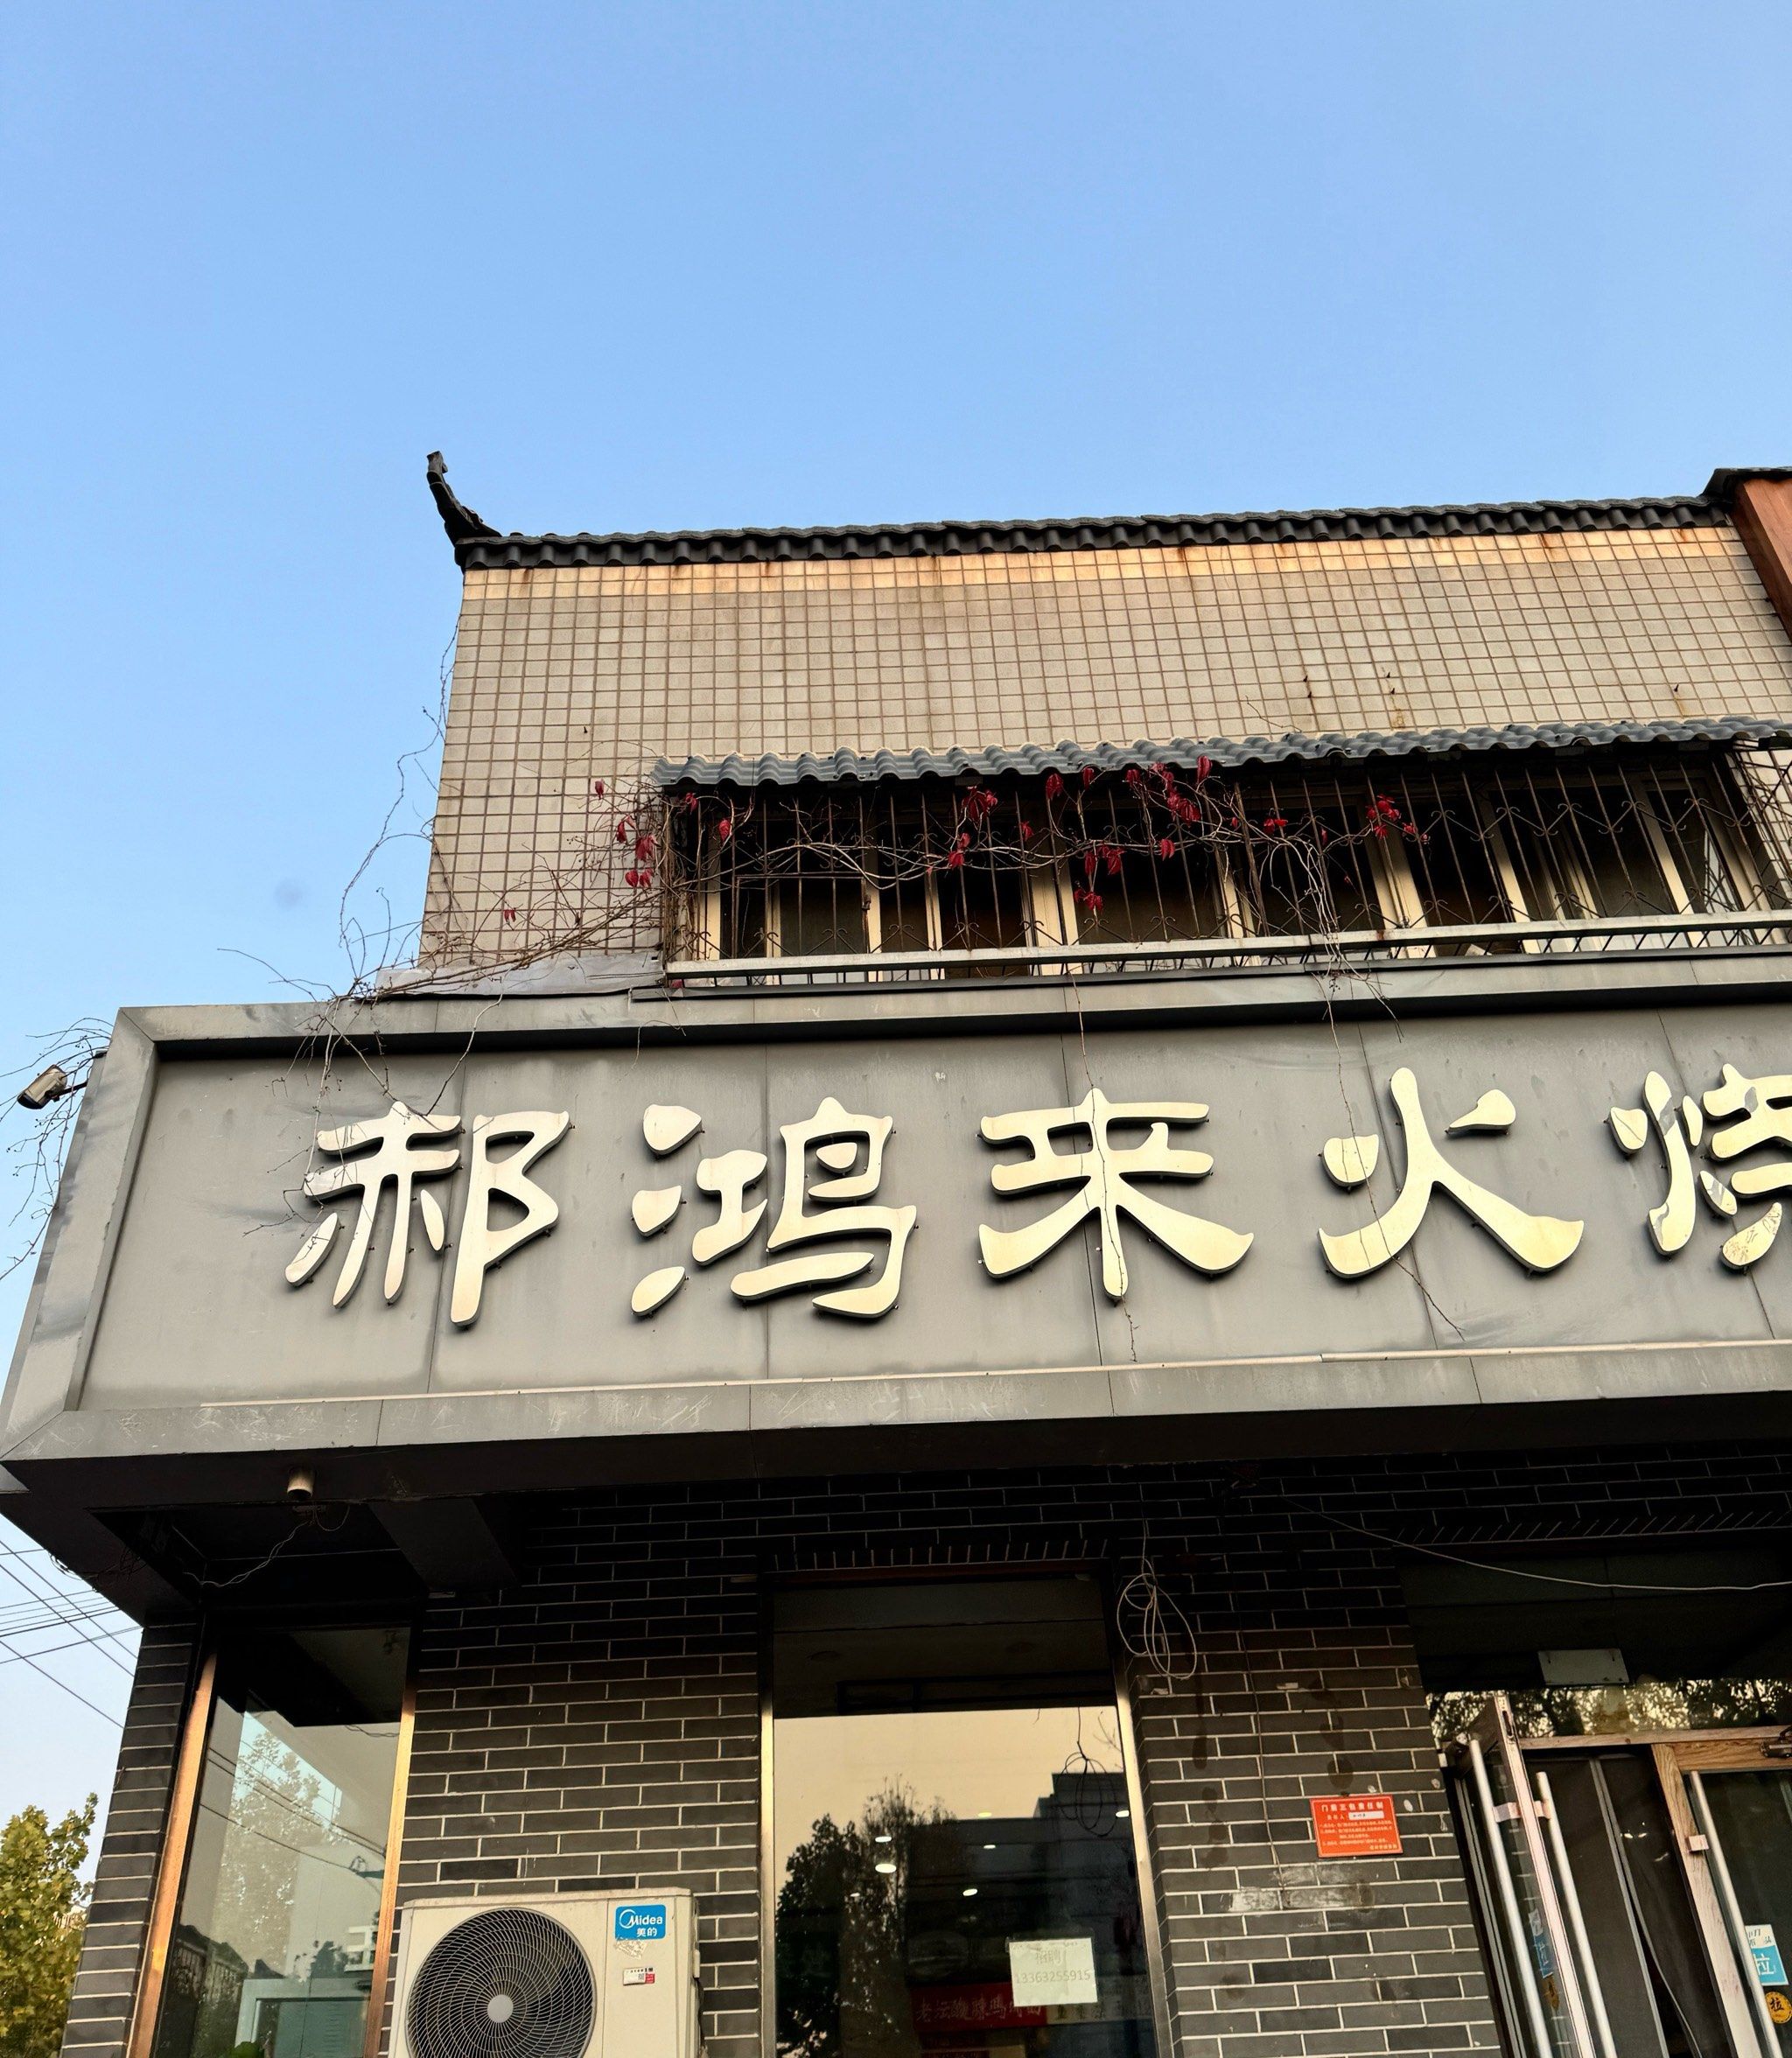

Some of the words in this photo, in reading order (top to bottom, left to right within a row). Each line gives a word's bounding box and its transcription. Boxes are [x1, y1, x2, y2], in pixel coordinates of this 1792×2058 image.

[619, 1908, 663, 1928] Midea
[637, 1927, 658, 1937] 美的
[1754, 1952, 1775, 1976] 拉
[1016, 1969, 1091, 1984] 13363255915
[1770, 1998, 1785, 2012] 拉
